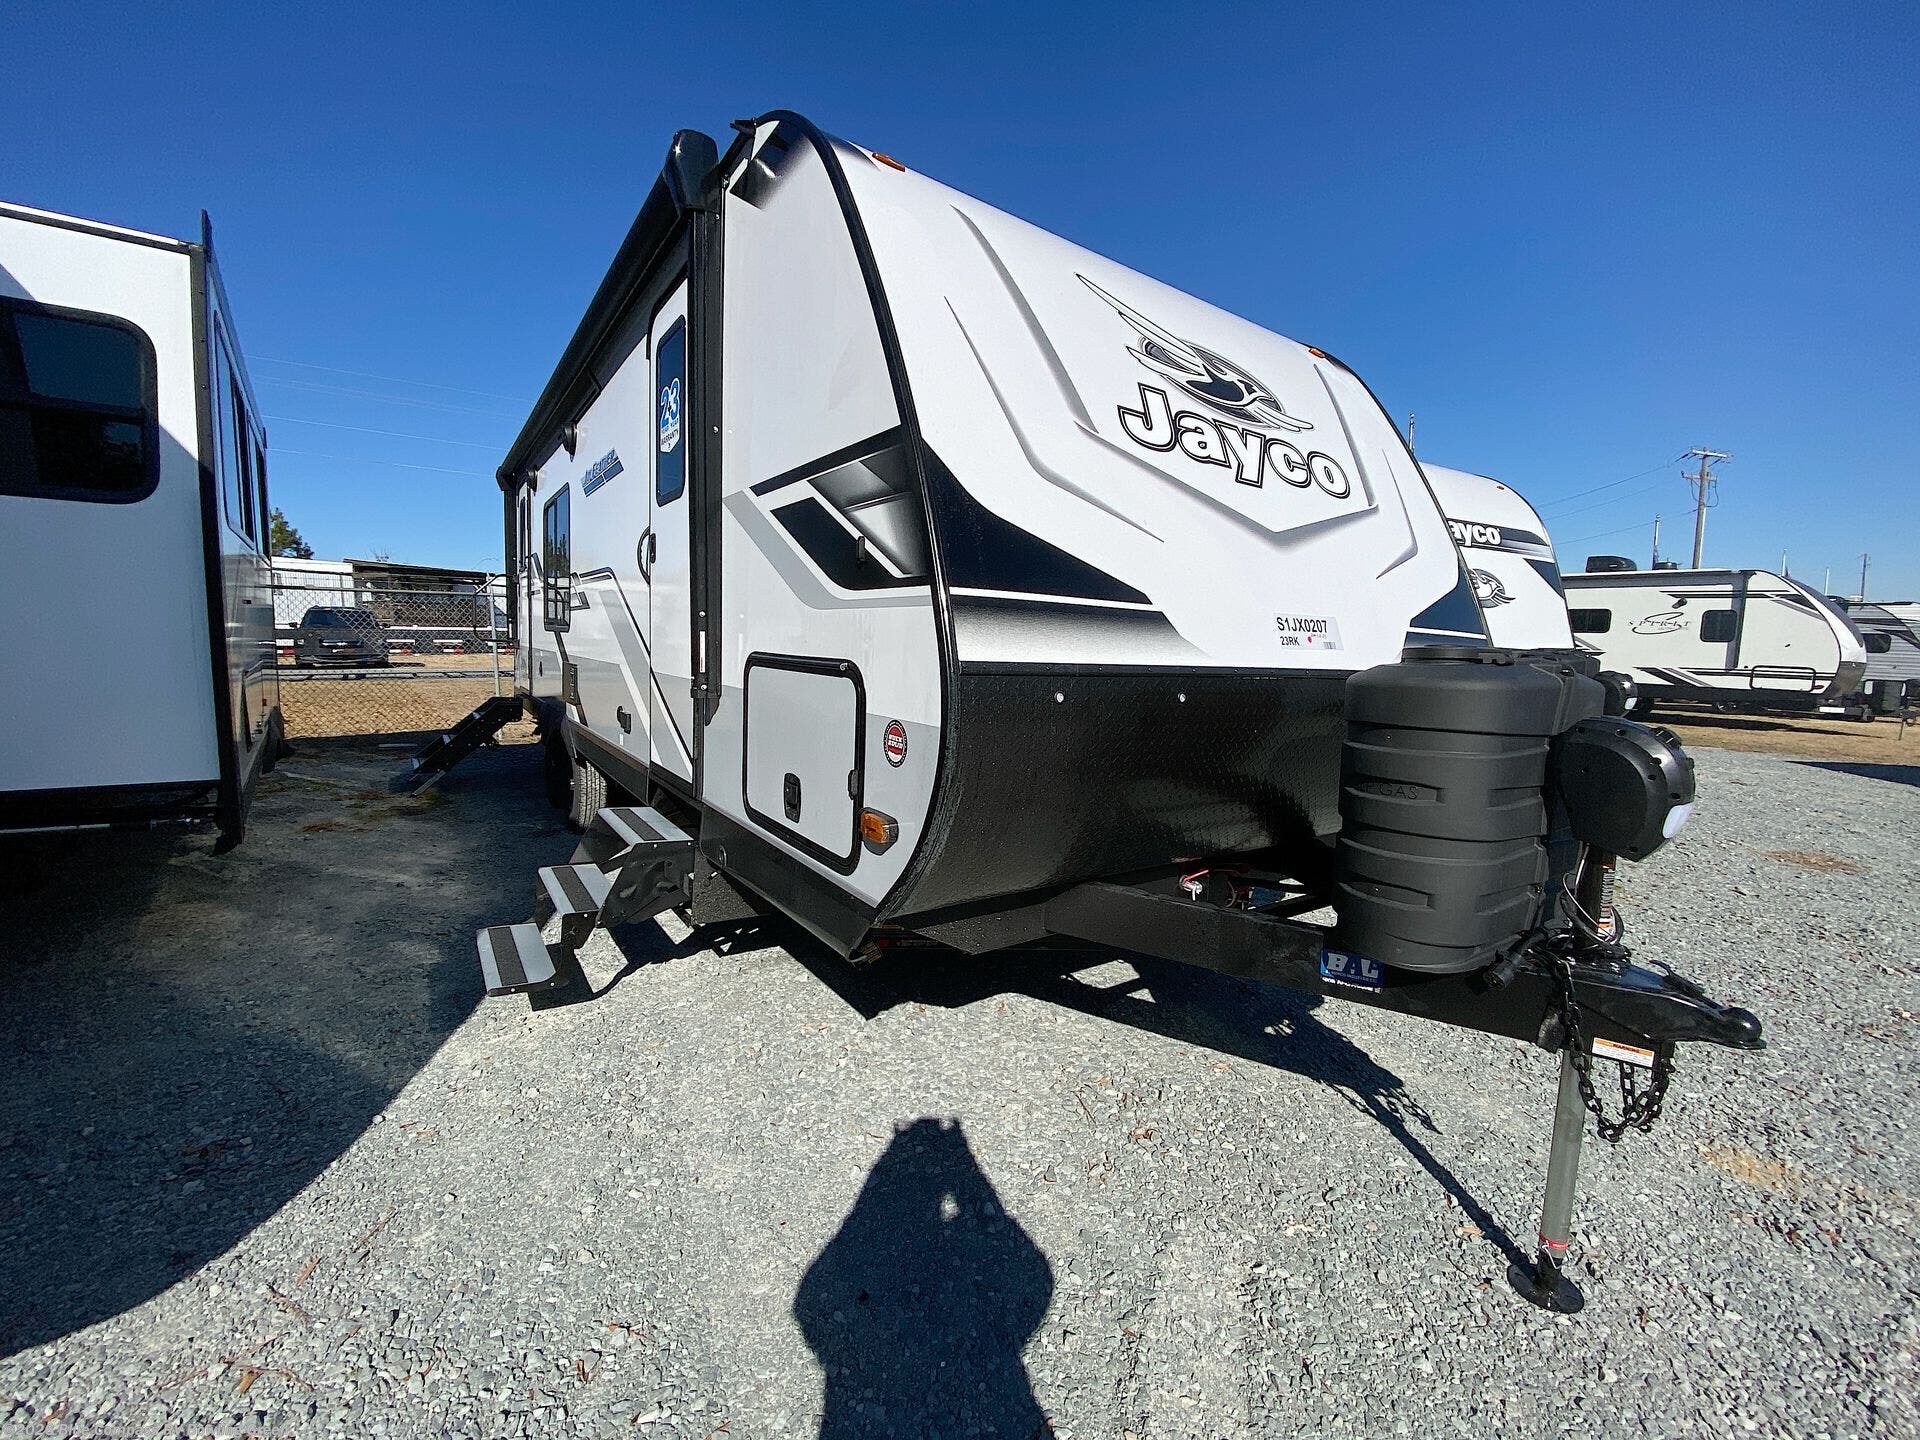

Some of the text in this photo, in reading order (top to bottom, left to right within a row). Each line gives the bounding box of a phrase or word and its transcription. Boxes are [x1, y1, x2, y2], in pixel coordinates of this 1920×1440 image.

[1117, 382, 1351, 500] Jayco
[1276, 616, 1328, 633] S1JX0207
[1279, 635, 1300, 646] 23RK
[1379, 782, 1418, 800] GAS
